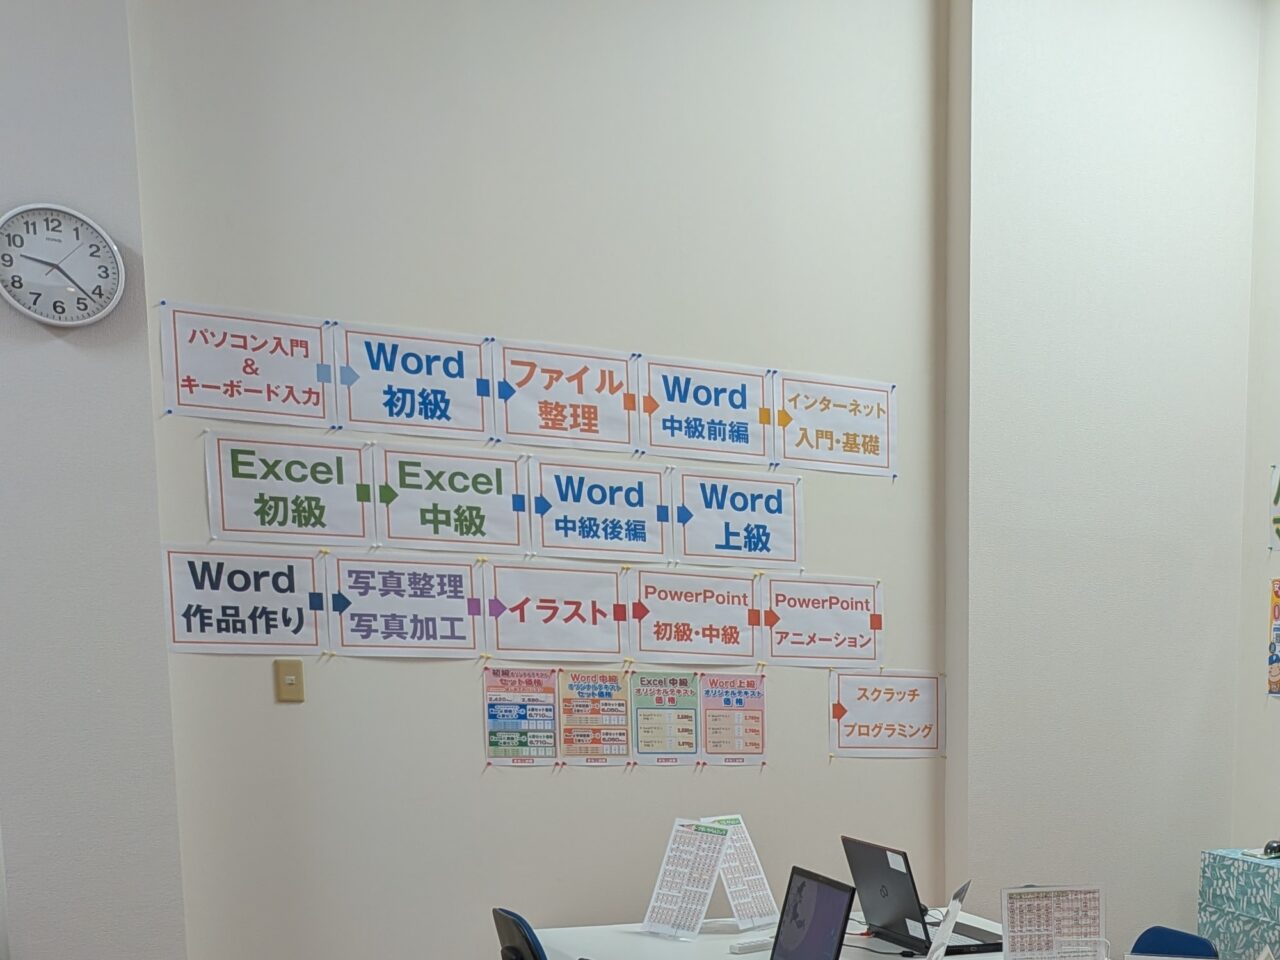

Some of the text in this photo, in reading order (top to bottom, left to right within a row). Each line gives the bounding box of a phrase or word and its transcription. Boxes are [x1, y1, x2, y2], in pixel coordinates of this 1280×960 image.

[23, 220, 37, 235] 11
[44, 217, 62, 233] 12
[73, 227, 80, 241] 1
[5, 233, 25, 248] 10
[89, 244, 101, 258] 2
[1, 253, 14, 268] 9
[97, 265, 110, 279] 3
[11, 275, 24, 289] 8
[91, 285, 104, 298] 4
[29, 291, 42, 306] 7
[52, 300, 66, 315] 6
[76, 297, 89, 312] 5
[188, 328, 309, 358] パソコン入門
[242, 358, 260, 376] &
[364, 341, 465, 379] Word
[510, 359, 624, 396] ファイル
[180, 376, 321, 407] キーボード入力
[383, 384, 452, 421] 初級
[661, 374, 747, 410] Word
[537, 400, 599, 434] 整理
[787, 393, 887, 419] インターネット
[661, 416, 750, 444] 中級前編
[795, 427, 881, 456] 入門・基礎
[230, 449, 344, 485] Excel
[399, 461, 503, 495] Excel
[554, 474, 645, 508] Word
[699, 482, 783, 514] Word
[254, 493, 327, 528] 初級
[420, 503, 487, 537] 中級
[554, 515, 647, 542] 中級後編
[715, 522, 771, 553] 上級
[187, 560, 296, 594] Word
[347, 569, 464, 600] 写真整理
[644, 585, 749, 607] PowerPoint
[775, 593, 871, 613] PowerPoint
[182, 604, 305, 635] 作品作り
[508, 598, 608, 626] イラスト
[350, 613, 467, 641] 写真加工
[653, 622, 740, 645] 初級・中級
[775, 631, 872, 650] アニメーション
[571, 673, 597, 682] Word
[640, 677, 667, 686] Excel
[709, 679, 735, 688] Word
[635, 688, 695, 696] オリジナルテキスト
[705, 689, 763, 698] オリジナルテキスト
[857, 687, 920, 702] スクラッチ
[844, 722, 933, 738] プログラミング
